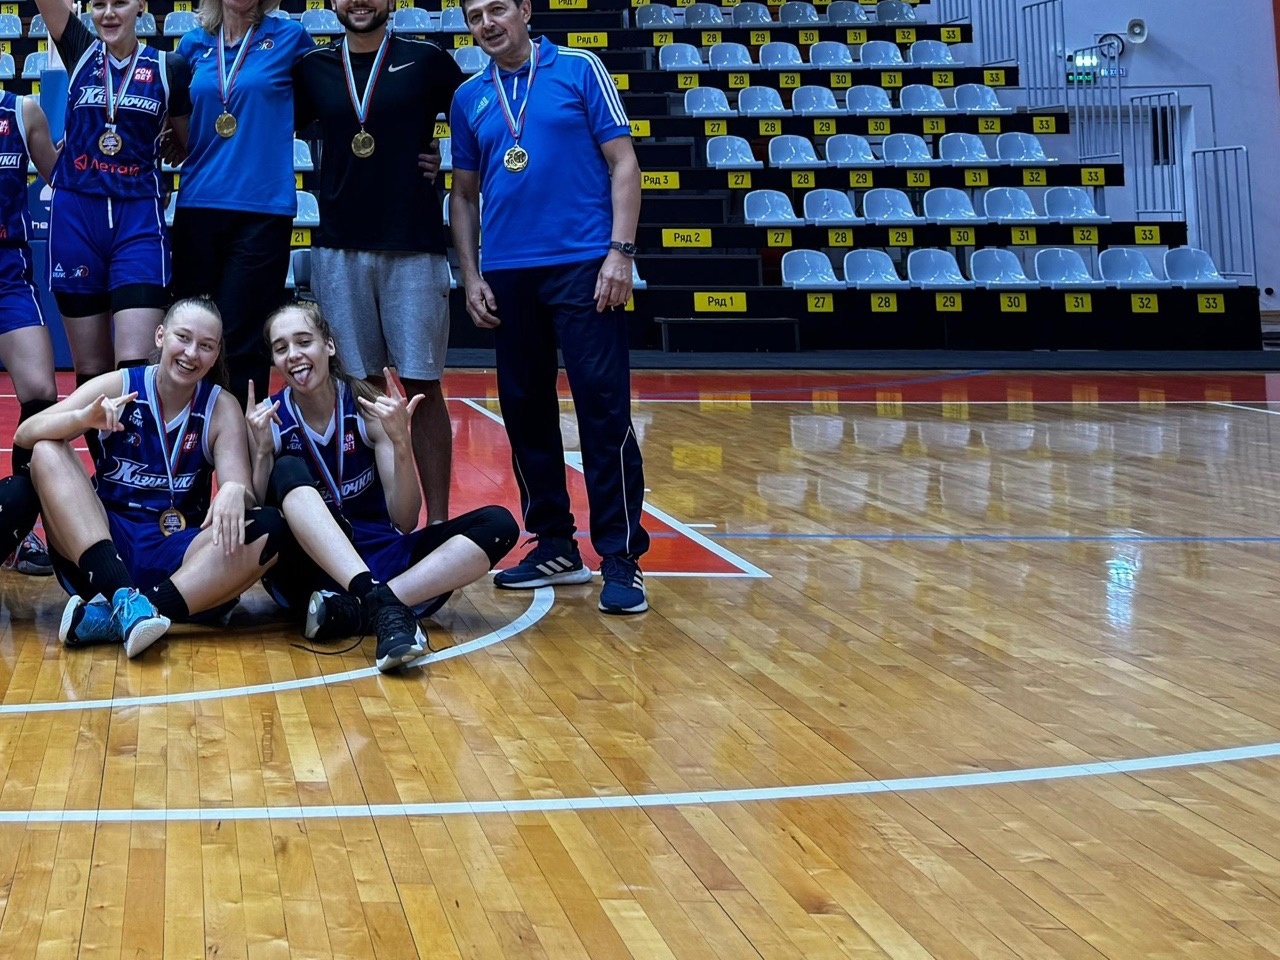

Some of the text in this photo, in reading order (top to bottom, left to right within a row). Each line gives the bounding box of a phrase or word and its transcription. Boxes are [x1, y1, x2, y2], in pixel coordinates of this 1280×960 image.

[5, 5, 14, 14] 15
[178, 3, 188, 11] 19
[310, 1, 320, 10] 22
[400, 0, 410, 9] 24
[446, 0, 456, 8] 25
[458, 36, 469, 45] 25
[576, 35, 599, 44] Ряд 6
[658, 34, 669, 44] 27
[706, 32, 717, 43] 28
[754, 33, 766, 43] 29
[803, 32, 815, 42] 30
[852, 32, 862, 41] 31
[901, 32, 911, 40] 32
[945, 30, 956, 40] 33
[683, 76, 694, 86] 27
[733, 75, 745, 86] 28
[784, 75, 796, 85] 29
[835, 75, 847, 85] 30
[887, 74, 897, 85] 31
[937, 74, 949, 84] 32
[989, 72, 1000, 83] 33
[435, 125, 447, 135] 24
[710, 122, 721, 133] 27
[764, 122, 776, 133] 28
[819, 121, 831, 132] 29
[873, 121, 885, 132] 30
[929, 121, 939, 131] 31
[983, 121, 995, 131] 32
[1038, 119, 1050, 130] 33
[643, 175, 669, 186] Ряд 3
[733, 175, 745, 186] 27
[797, 174, 810, 185] 28
[855, 174, 868, 184] 29
[912, 173, 925, 184] 30
[971, 172, 982, 183] 31
[1029, 172, 1041, 183] 32
[1087, 171, 1100, 182] 33
[294, 232, 304, 243] 21
[674, 232, 701, 244] Ряд 2
[773, 233, 785, 244] 27
[834, 232, 848, 243] 28
[894, 231, 908, 243] 29
[956, 231, 969, 242] 30
[1019, 231, 1030, 242] 31
[1079, 230, 1093, 241] 32
[1141, 229, 1154, 241] 33
[707, 296, 726, 309] Ряд
[813, 296, 826, 309] 27
[877, 296, 891, 308] 28
[942, 296, 956, 308] 29
[1006, 296, 1021, 308] 30
[1073, 296, 1085, 309] 31
[1137, 296, 1152, 309] 32
[1204, 297, 1218, 309] 33
